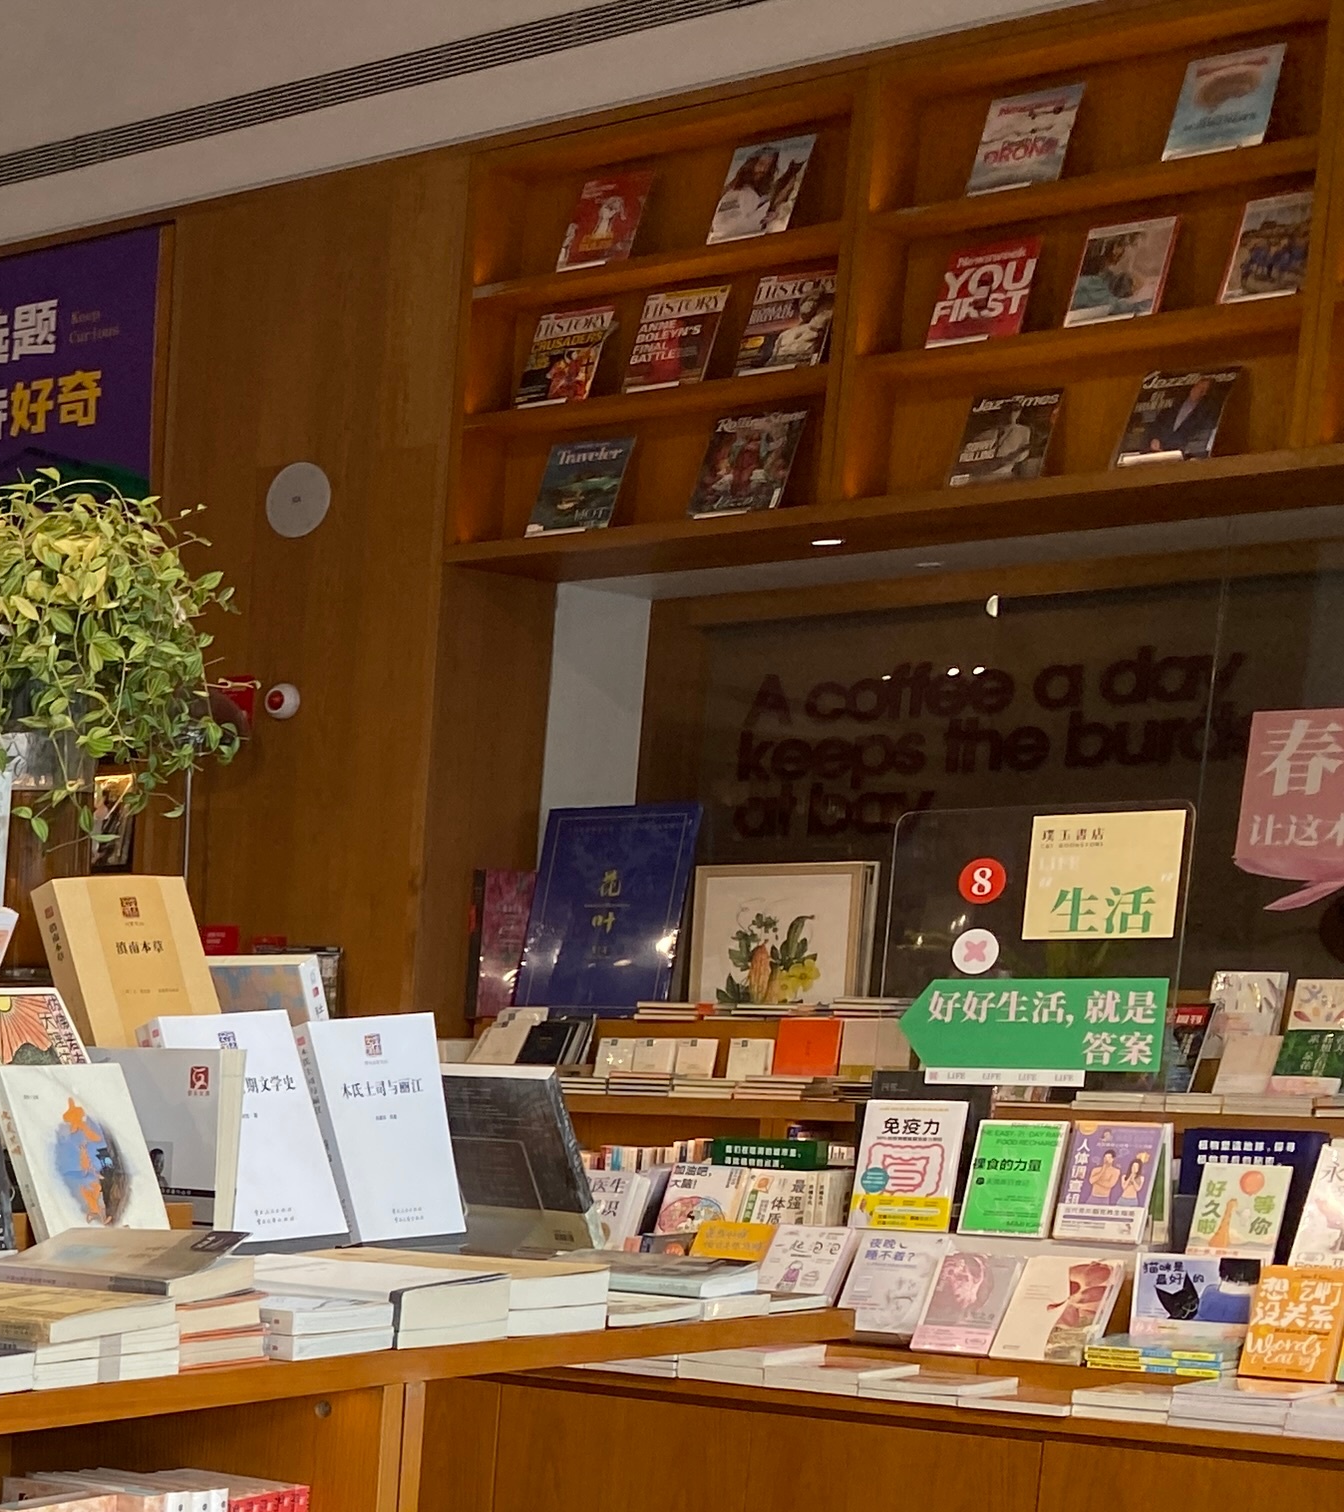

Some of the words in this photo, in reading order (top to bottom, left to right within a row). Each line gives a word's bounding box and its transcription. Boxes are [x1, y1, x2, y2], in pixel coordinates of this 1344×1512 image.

[757, 274, 837, 302] HISTORY
[943, 258, 1038, 300] YOU
[641, 294, 722, 322] HISTORY
[931, 289, 1030, 325] FIRST
[533, 312, 612, 343] HISTORY
[635, 324, 701, 345] BOLEYN'S
[638, 319, 677, 334] ANNE
[632, 341, 668, 355] FINAL
[556, 447, 623, 467] Traveler
[743, 673, 791, 728] A
[804, 662, 1015, 723] coffee
[1033, 664, 1084, 712] a
[1099, 646, 1247, 711] day
[736, 729, 928, 792] keeps
[942, 718, 1051, 774] the
[733, 784, 798, 838] at
[970, 867, 994, 897] 8
[1048, 884, 1157, 935] 生活
[115, 940, 165, 956] 滇南本草
[1081, 1031, 1154, 1066] 答案
[342, 1077, 425, 1100] 木氏土司与丽江
[883, 1117, 941, 1136] 免疫力
[1250, 1302, 1336, 1331] 没关系
